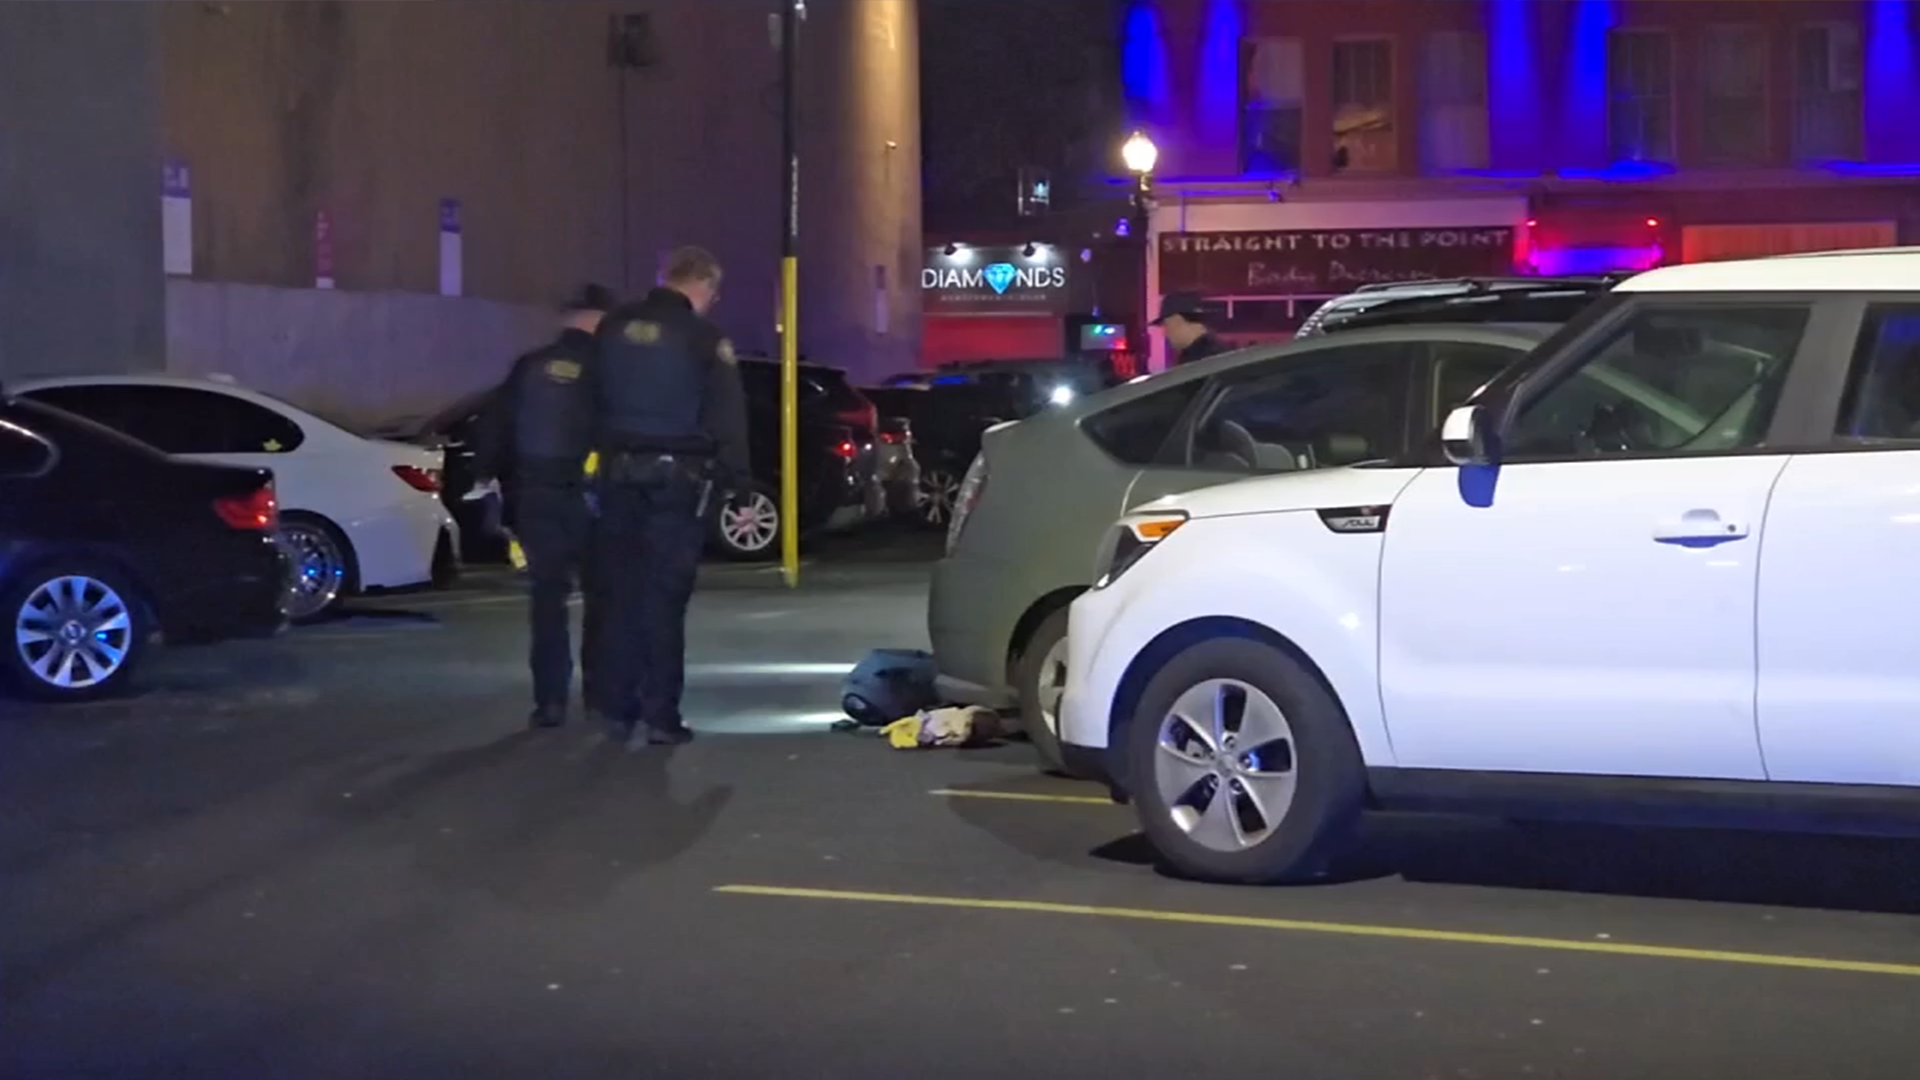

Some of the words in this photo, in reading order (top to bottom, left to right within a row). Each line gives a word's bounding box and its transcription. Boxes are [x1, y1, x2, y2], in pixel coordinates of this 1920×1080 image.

[1162, 234, 1302, 251] STRAIGHT
[1312, 233, 1350, 249] TO
[1359, 231, 1410, 248] THE
[1421, 229, 1510, 247] POINT
[921, 267, 1065, 293] DIAMNDS
